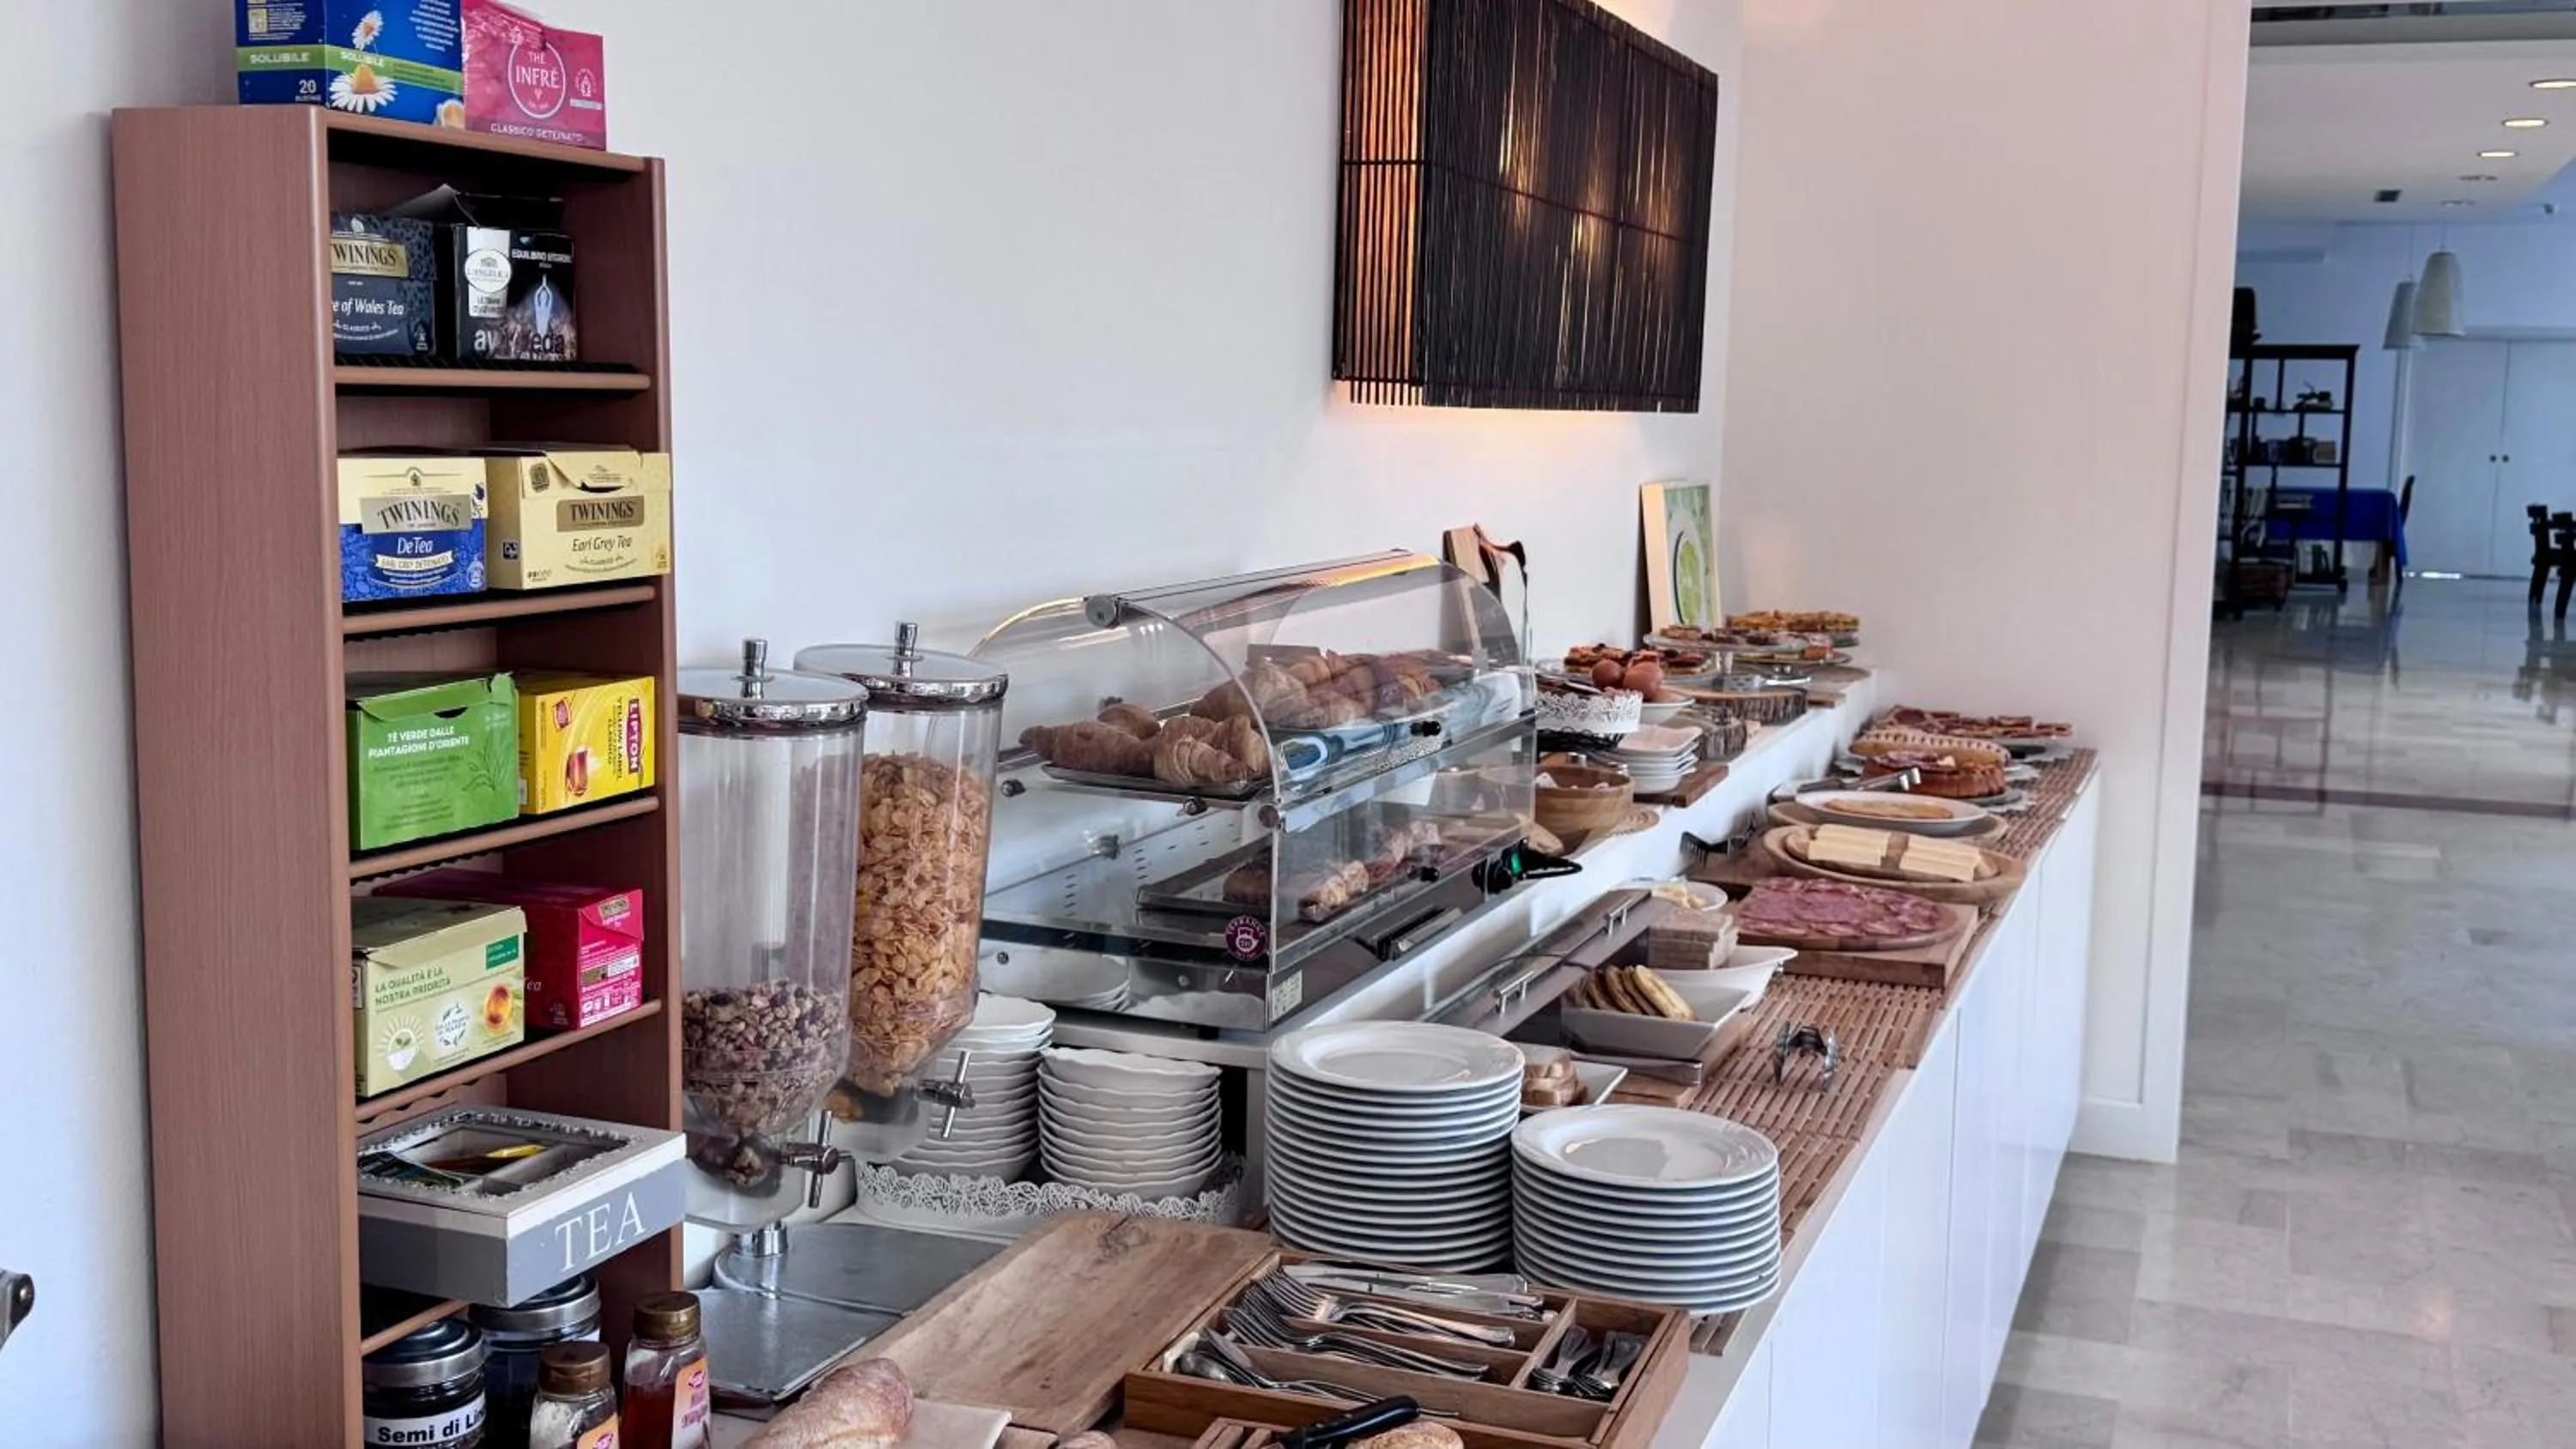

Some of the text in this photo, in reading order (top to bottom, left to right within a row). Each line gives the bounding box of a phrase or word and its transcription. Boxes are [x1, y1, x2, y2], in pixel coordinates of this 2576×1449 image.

[250, 52, 310, 64] SOLUBILE
[299, 79, 317, 94] 20
[331, 242, 398, 266] WININGS
[341, 297, 353, 316] of
[355, 298, 386, 315] Wales
[386, 300, 404, 316] Tea
[377, 500, 460, 530] TWININGS
[570, 500, 635, 523] TWININGS
[572, 534, 633, 552] Earl Grey Tea
[399, 729, 428, 741] VERDE
[429, 725, 454, 737] DALLE
[630, 702, 640, 770] LIPTON
[368, 742, 427, 759] PIANTAGIONI
[375, 990, 410, 1006] NOSTRA
[554, 1191, 647, 1271] TEA
[378, 1425, 434, 1442] Semi
[442, 1418, 459, 1437] di
